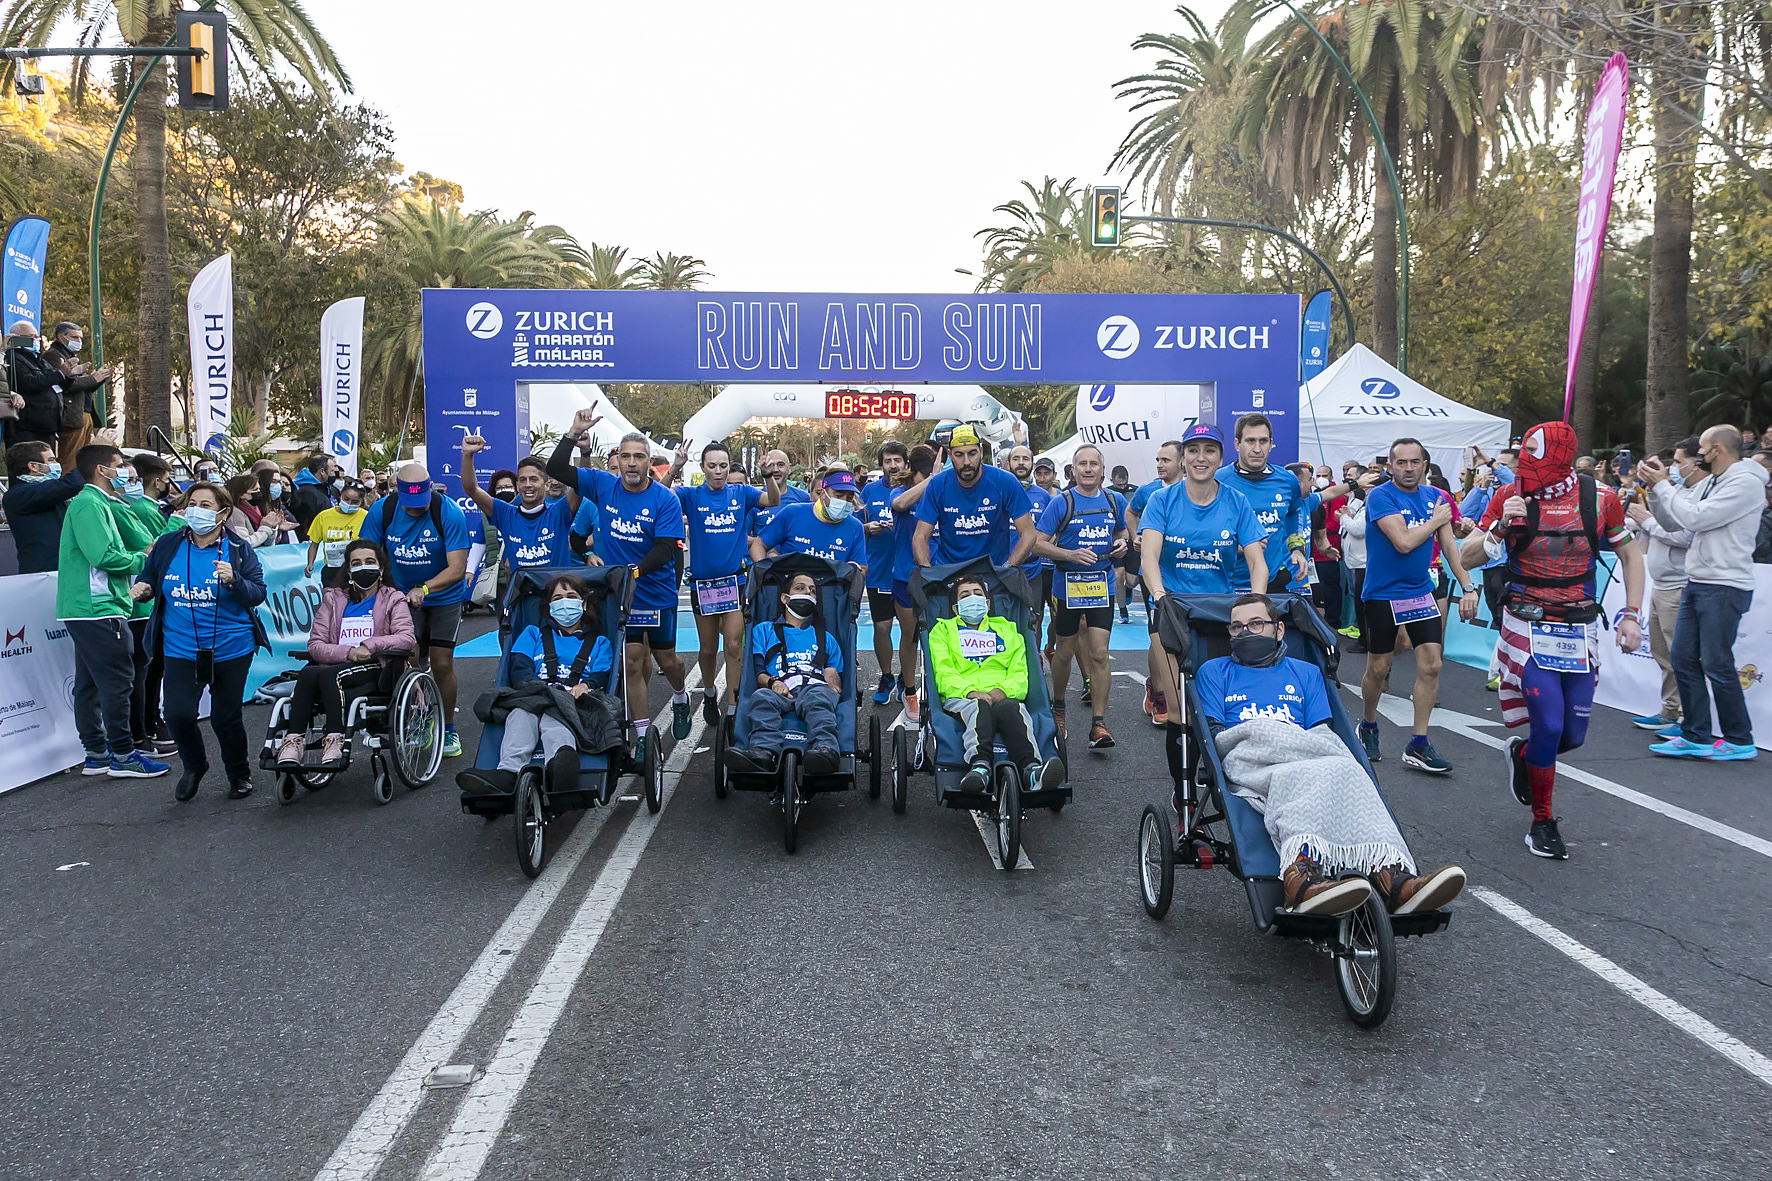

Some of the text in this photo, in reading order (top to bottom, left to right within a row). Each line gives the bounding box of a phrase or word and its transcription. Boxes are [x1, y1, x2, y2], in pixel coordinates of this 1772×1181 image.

[8, 304, 35, 320] ZURICH
[514, 311, 614, 331] ZURICH
[534, 332, 615, 346] MARATÓN
[697, 301, 1042, 371] RUN AND SUN
[1153, 326, 1270, 349] ZURICH
[534, 347, 604, 361] MÁLAGA
[204, 313, 228, 421] ZURICH
[336, 343, 351, 419] ZURICH
[828, 395, 912, 416] 08:52:00
[1339, 405, 1450, 418] ZURICH
[634, 514, 654, 523] ZURICH
[1165, 535, 1186, 544] aefat
[829, 544, 847, 552] ZURICH
[961, 638, 996, 648] VARO
[1555, 642, 1577, 651] 4392
[1, 646, 33, 659] HEALTH
[9, 703, 16, 711] de
[16, 699, 36, 709] Málaga
